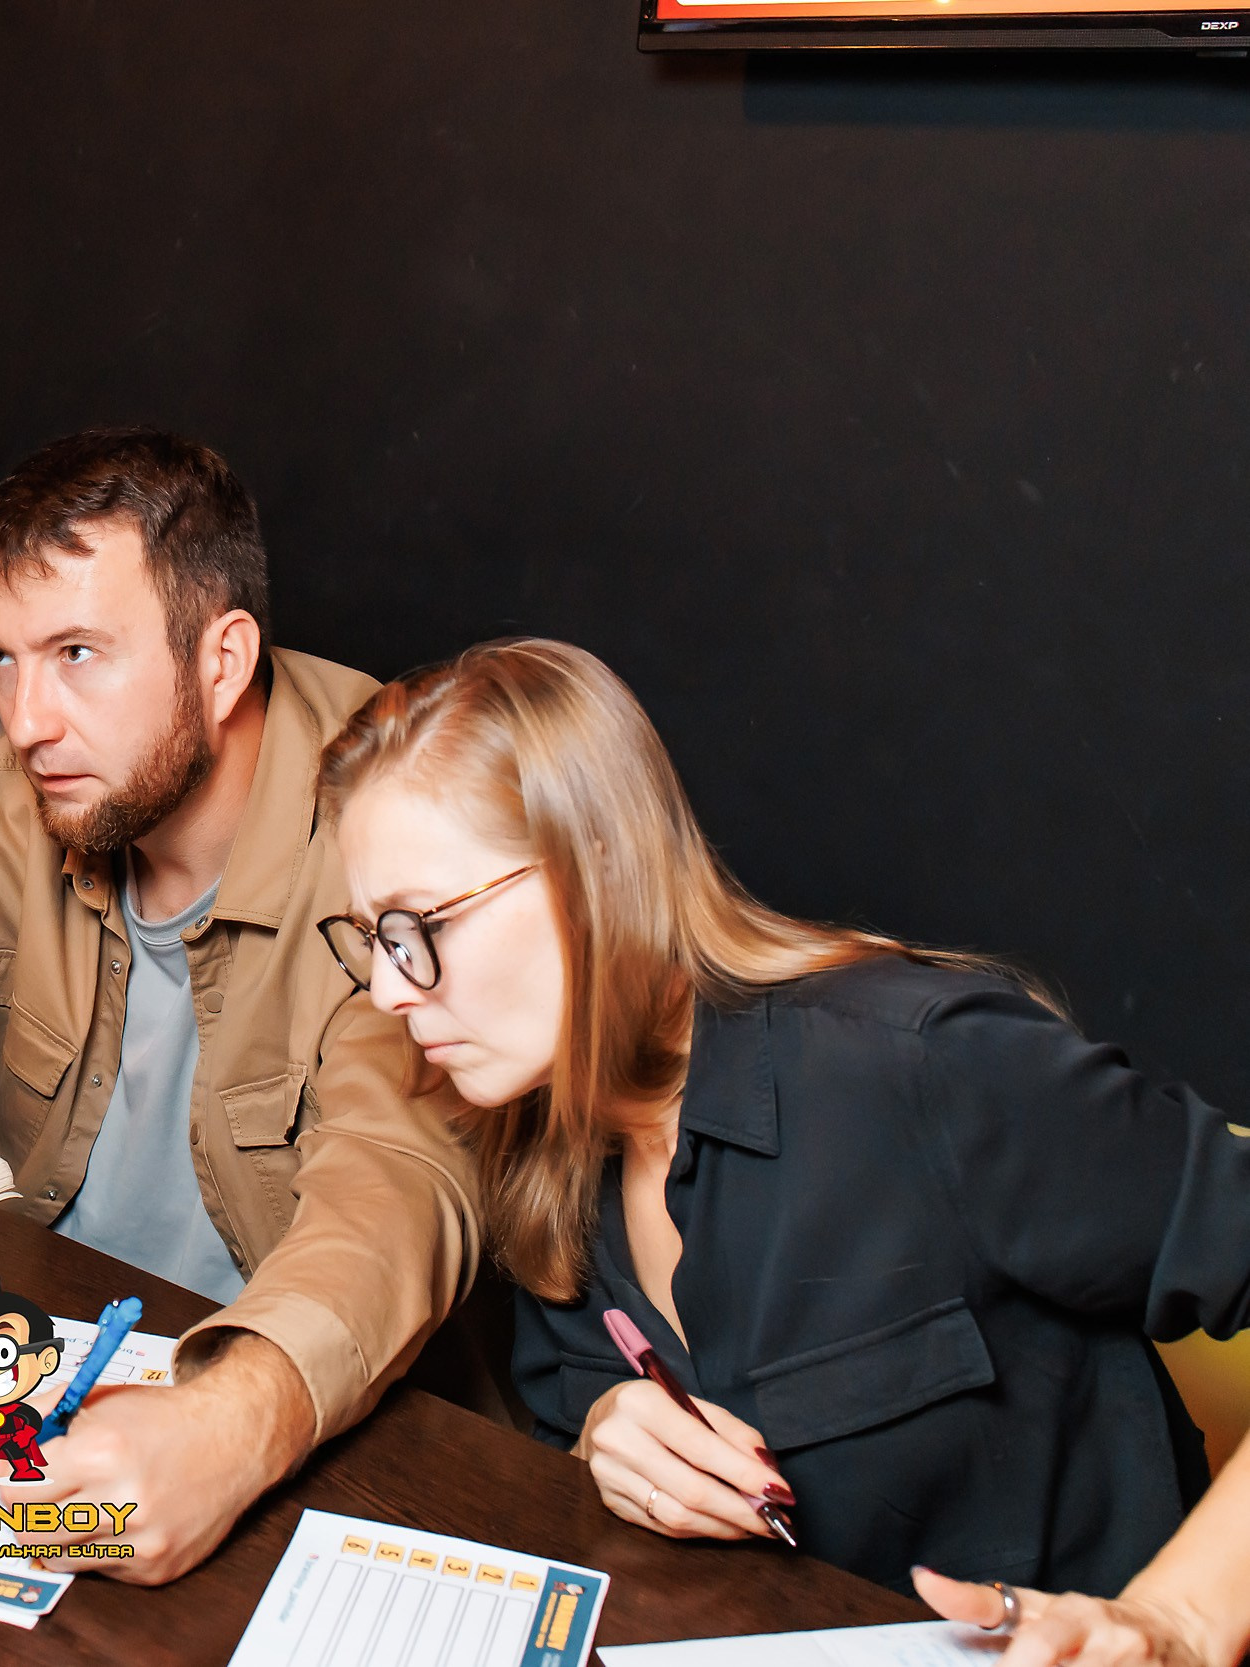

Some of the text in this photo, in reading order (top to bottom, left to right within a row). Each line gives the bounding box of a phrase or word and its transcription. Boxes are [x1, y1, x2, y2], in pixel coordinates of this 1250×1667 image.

[1200, 21, 1240, 30] DEXP
[147, 1371, 162, 1381] 12
[380, 1549, 400, 1558] 5
[447, 1562, 467, 1572] 3
[482, 1570, 503, 1580] 2
